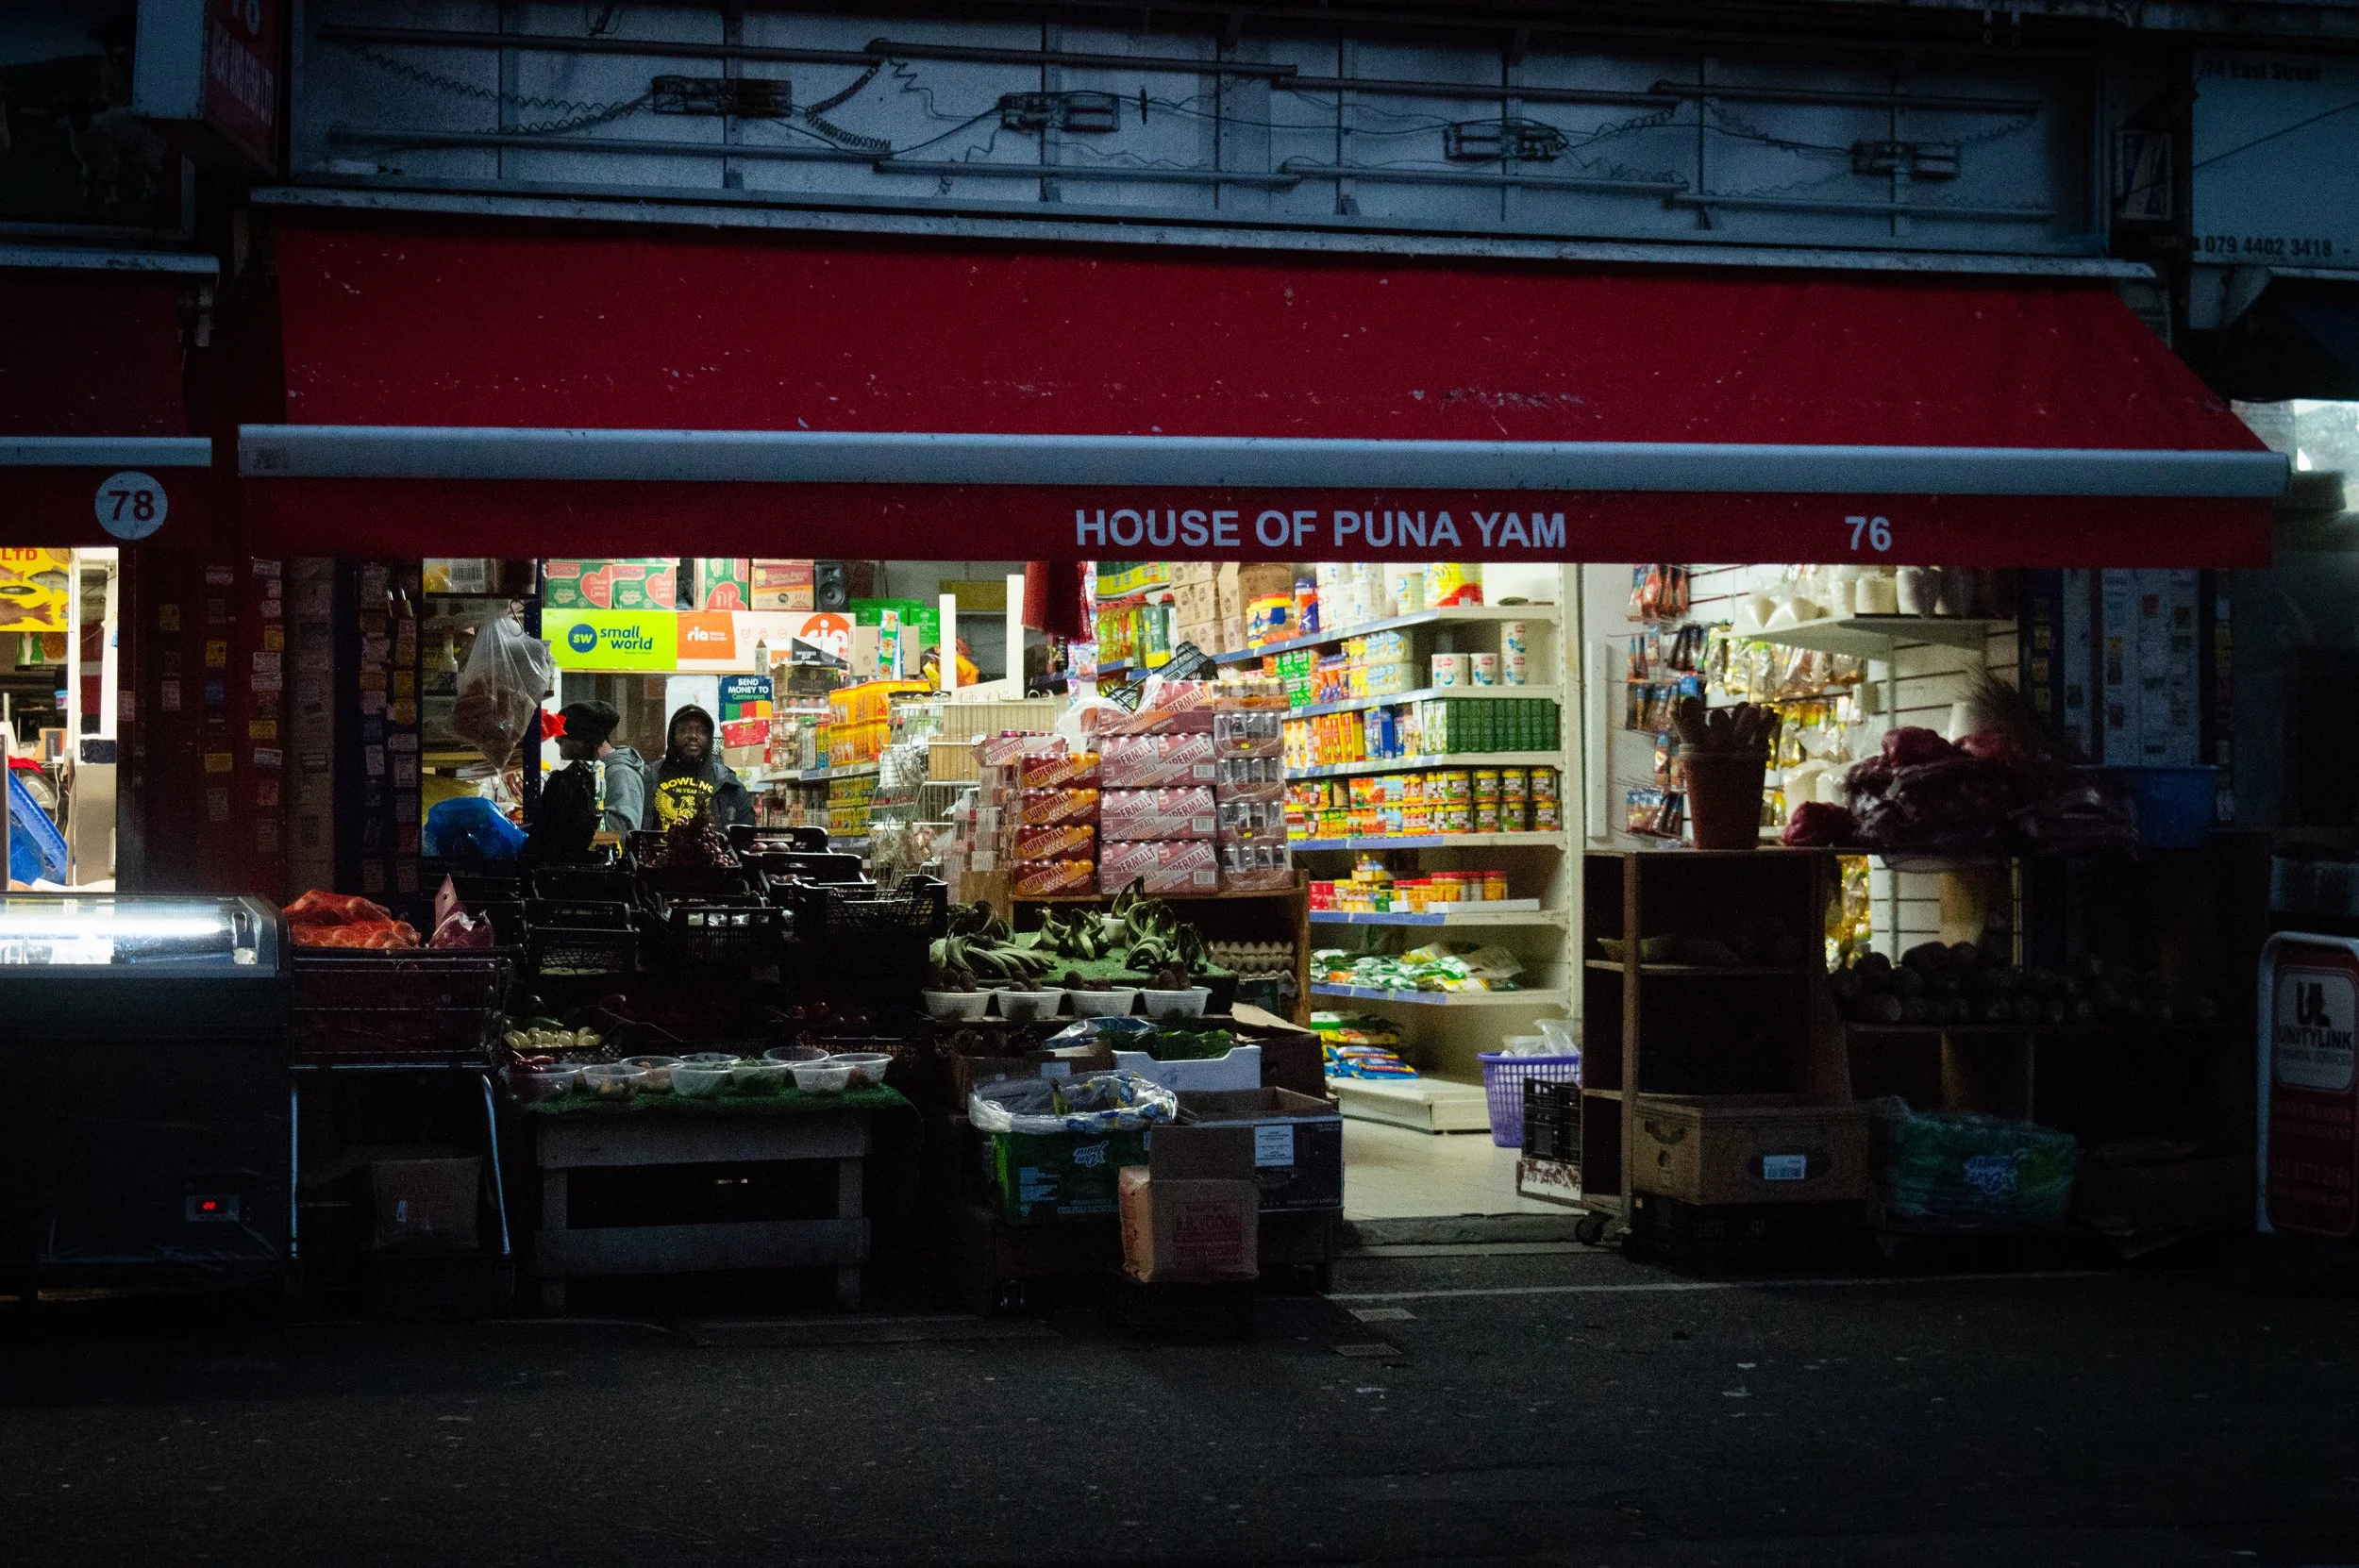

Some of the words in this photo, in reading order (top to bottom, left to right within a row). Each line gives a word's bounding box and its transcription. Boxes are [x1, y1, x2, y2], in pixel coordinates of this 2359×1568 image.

[2232, 60, 2267, 79] East
[2272, 61, 2322, 82] Street
[2205, 236, 2236, 253] 079
[2244, 237, 2284, 256] 4402
[2290, 239, 2332, 258] 3418
[109, 490, 154, 520] 78
[1075, 510, 1241, 547] HOUSE
[1255, 510, 1318, 547] OF
[1333, 510, 1464, 547] PUNA
[1472, 510, 1567, 549] YAM
[1845, 515, 1893, 552] 76
[2, 546, 38, 560] LTD
[600, 626, 640, 639] small
[611, 637, 653, 650] world
[687, 626, 709, 642] ria
[728, 686, 757, 694] MONEY
[759, 686, 769, 694] TO
[988, 740, 1026, 763] SUPERMALT
[1029, 758, 1074, 784] SUPERMALT
[1119, 764, 1157, 786] SUPERMALT
[660, 777, 714, 793] BOWLNG
[1029, 792, 1073, 821] SUPERMALT
[1118, 817, 1157, 840] SUPERMALT
[1023, 829, 1068, 854] SUPERMALT
[1023, 864, 1067, 892] SUPERMALT
